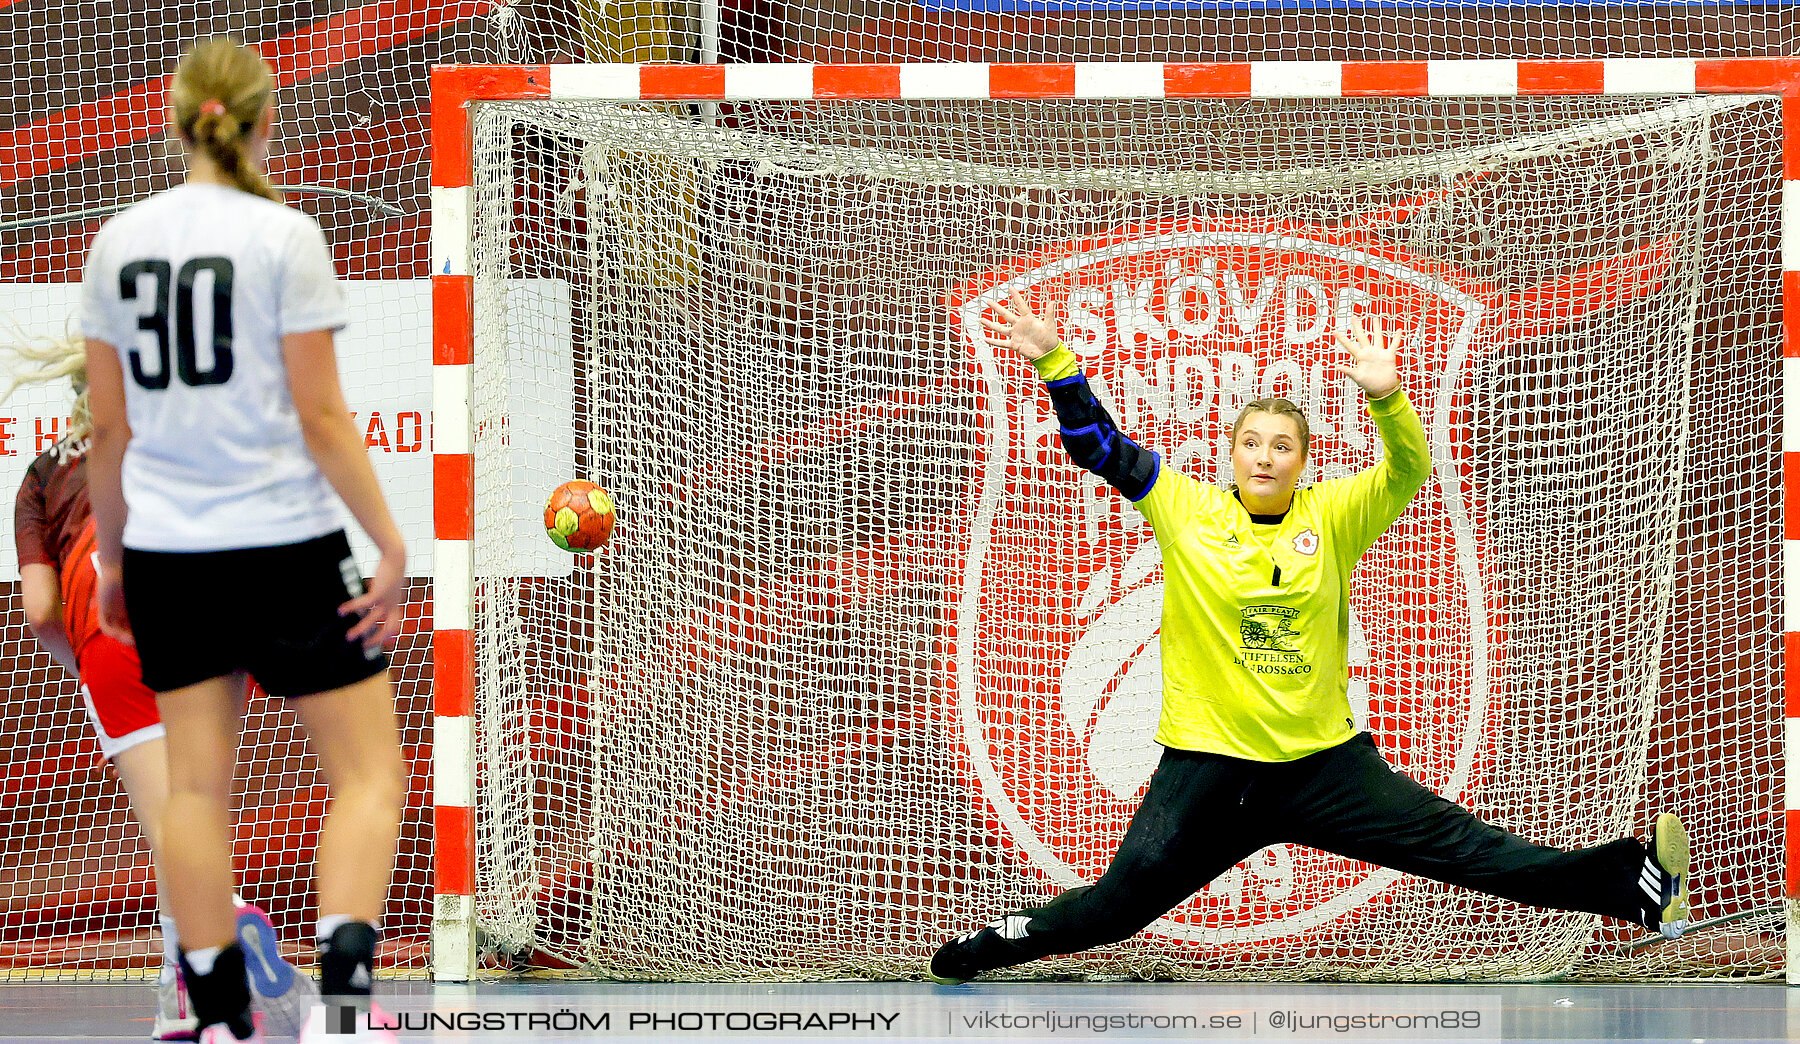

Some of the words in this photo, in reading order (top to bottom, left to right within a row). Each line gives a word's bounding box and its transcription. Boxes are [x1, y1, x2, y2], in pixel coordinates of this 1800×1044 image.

[118, 255, 235, 391] 30
[1066, 256, 1371, 358] SKÖVDE
[1271, 607, 1292, 615] PLAY
[1241, 651, 1304, 663] TIFTELSEN
